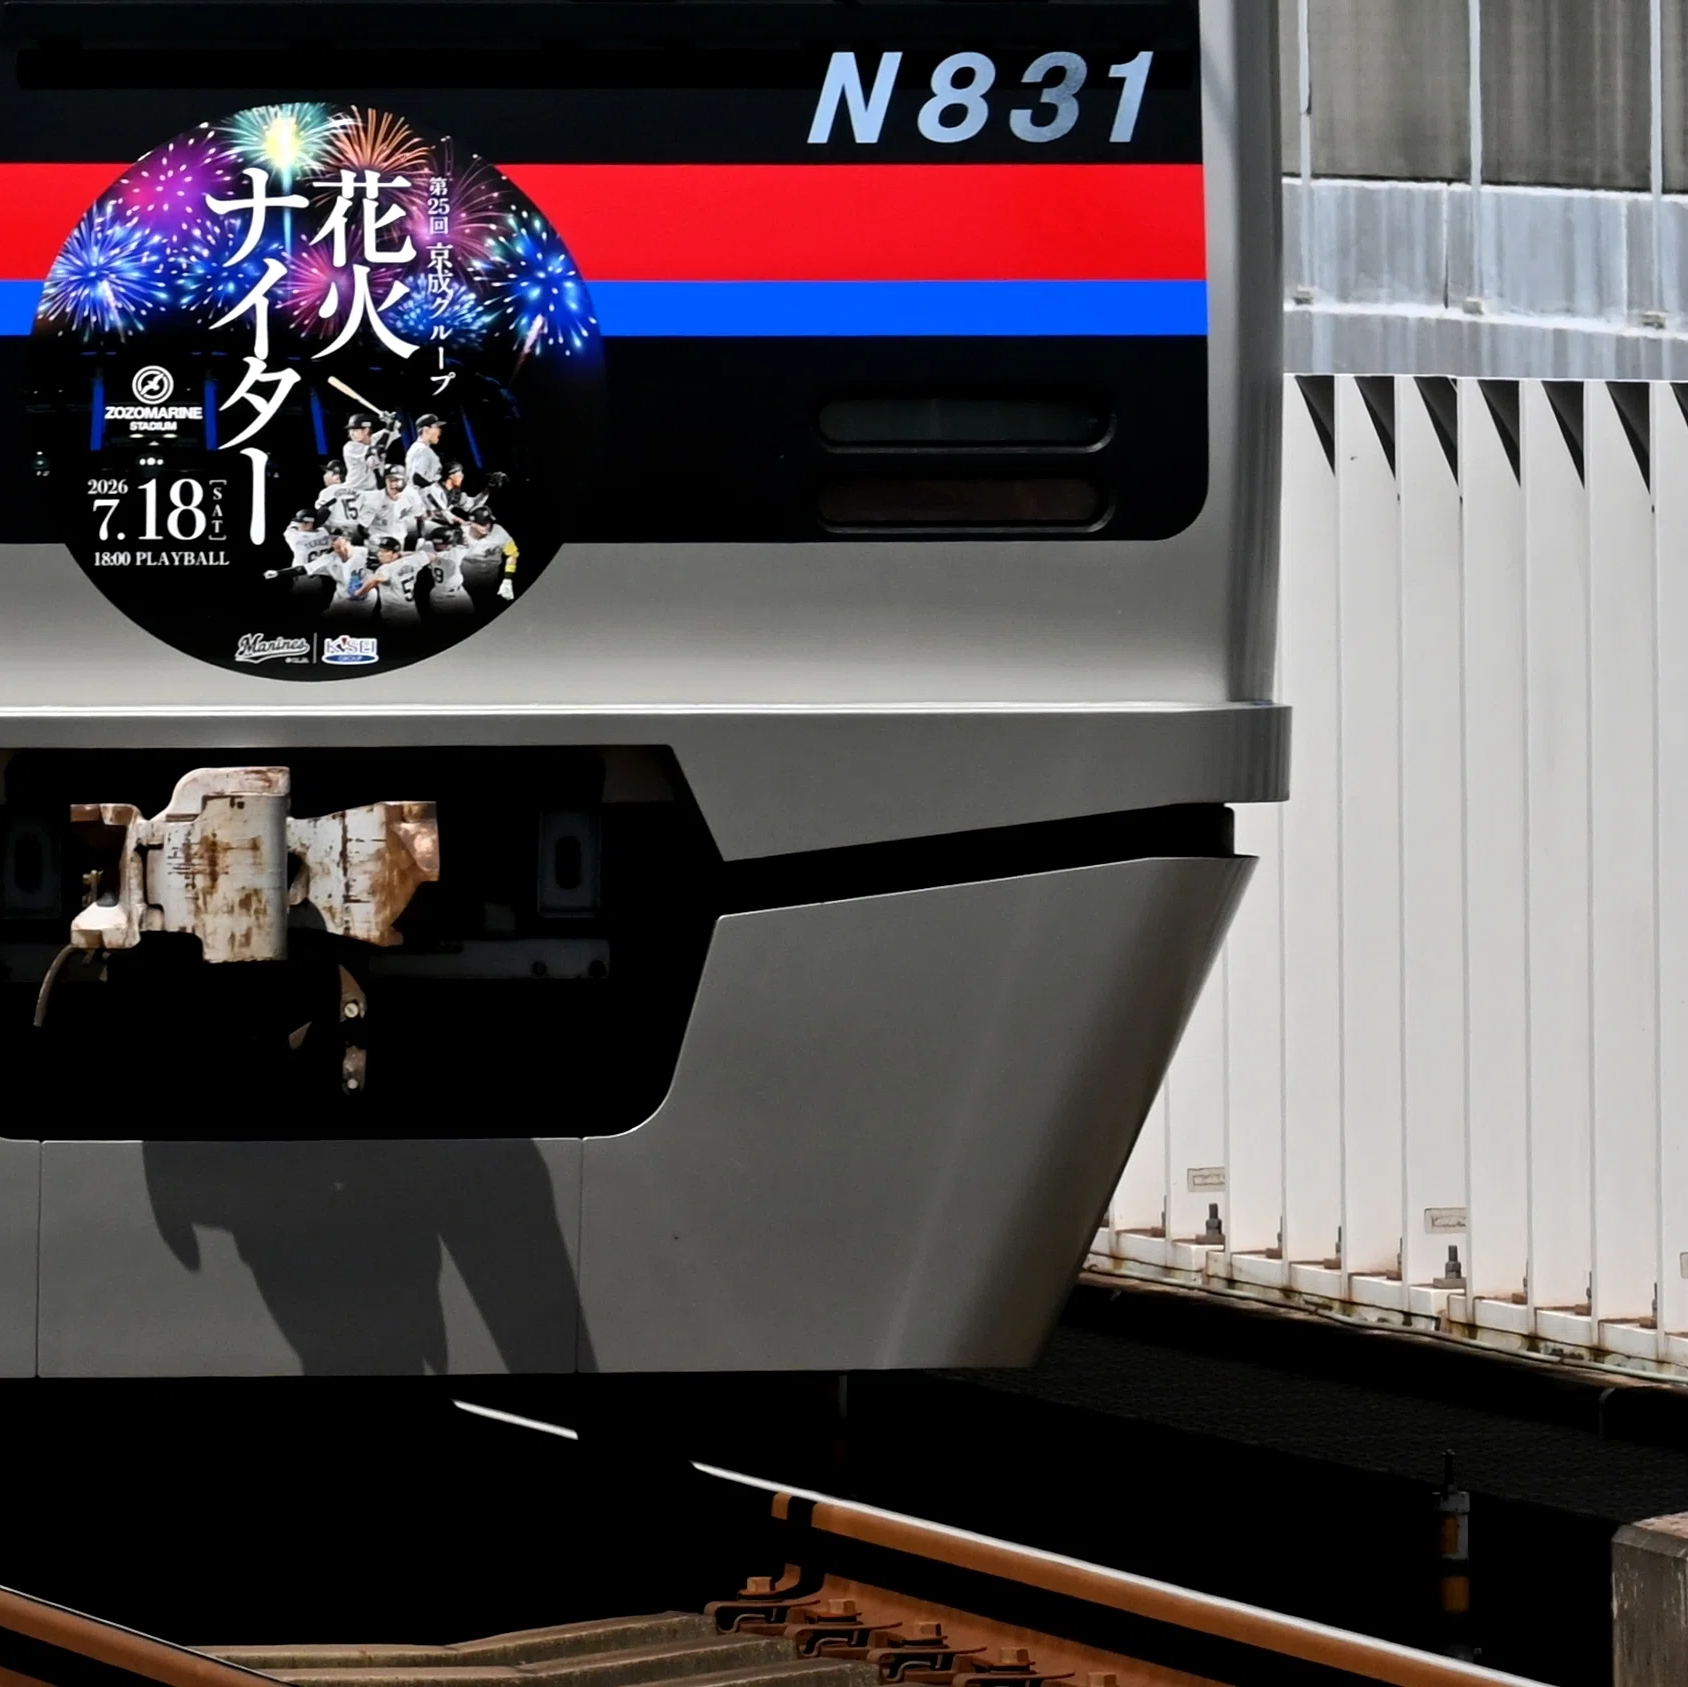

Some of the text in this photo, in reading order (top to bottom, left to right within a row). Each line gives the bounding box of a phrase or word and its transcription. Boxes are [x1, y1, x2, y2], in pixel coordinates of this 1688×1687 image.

[807, 51, 1154, 144] N831
[310, 169, 419, 360] 花火
[205, 168, 309, 546] ナイター
[129, 421, 178, 431] STADIUM
[87, 478, 129, 495] 2026
[94, 551, 230, 566] 18:00 PLAYBALL
[235, 632, 311, 661] Marines
